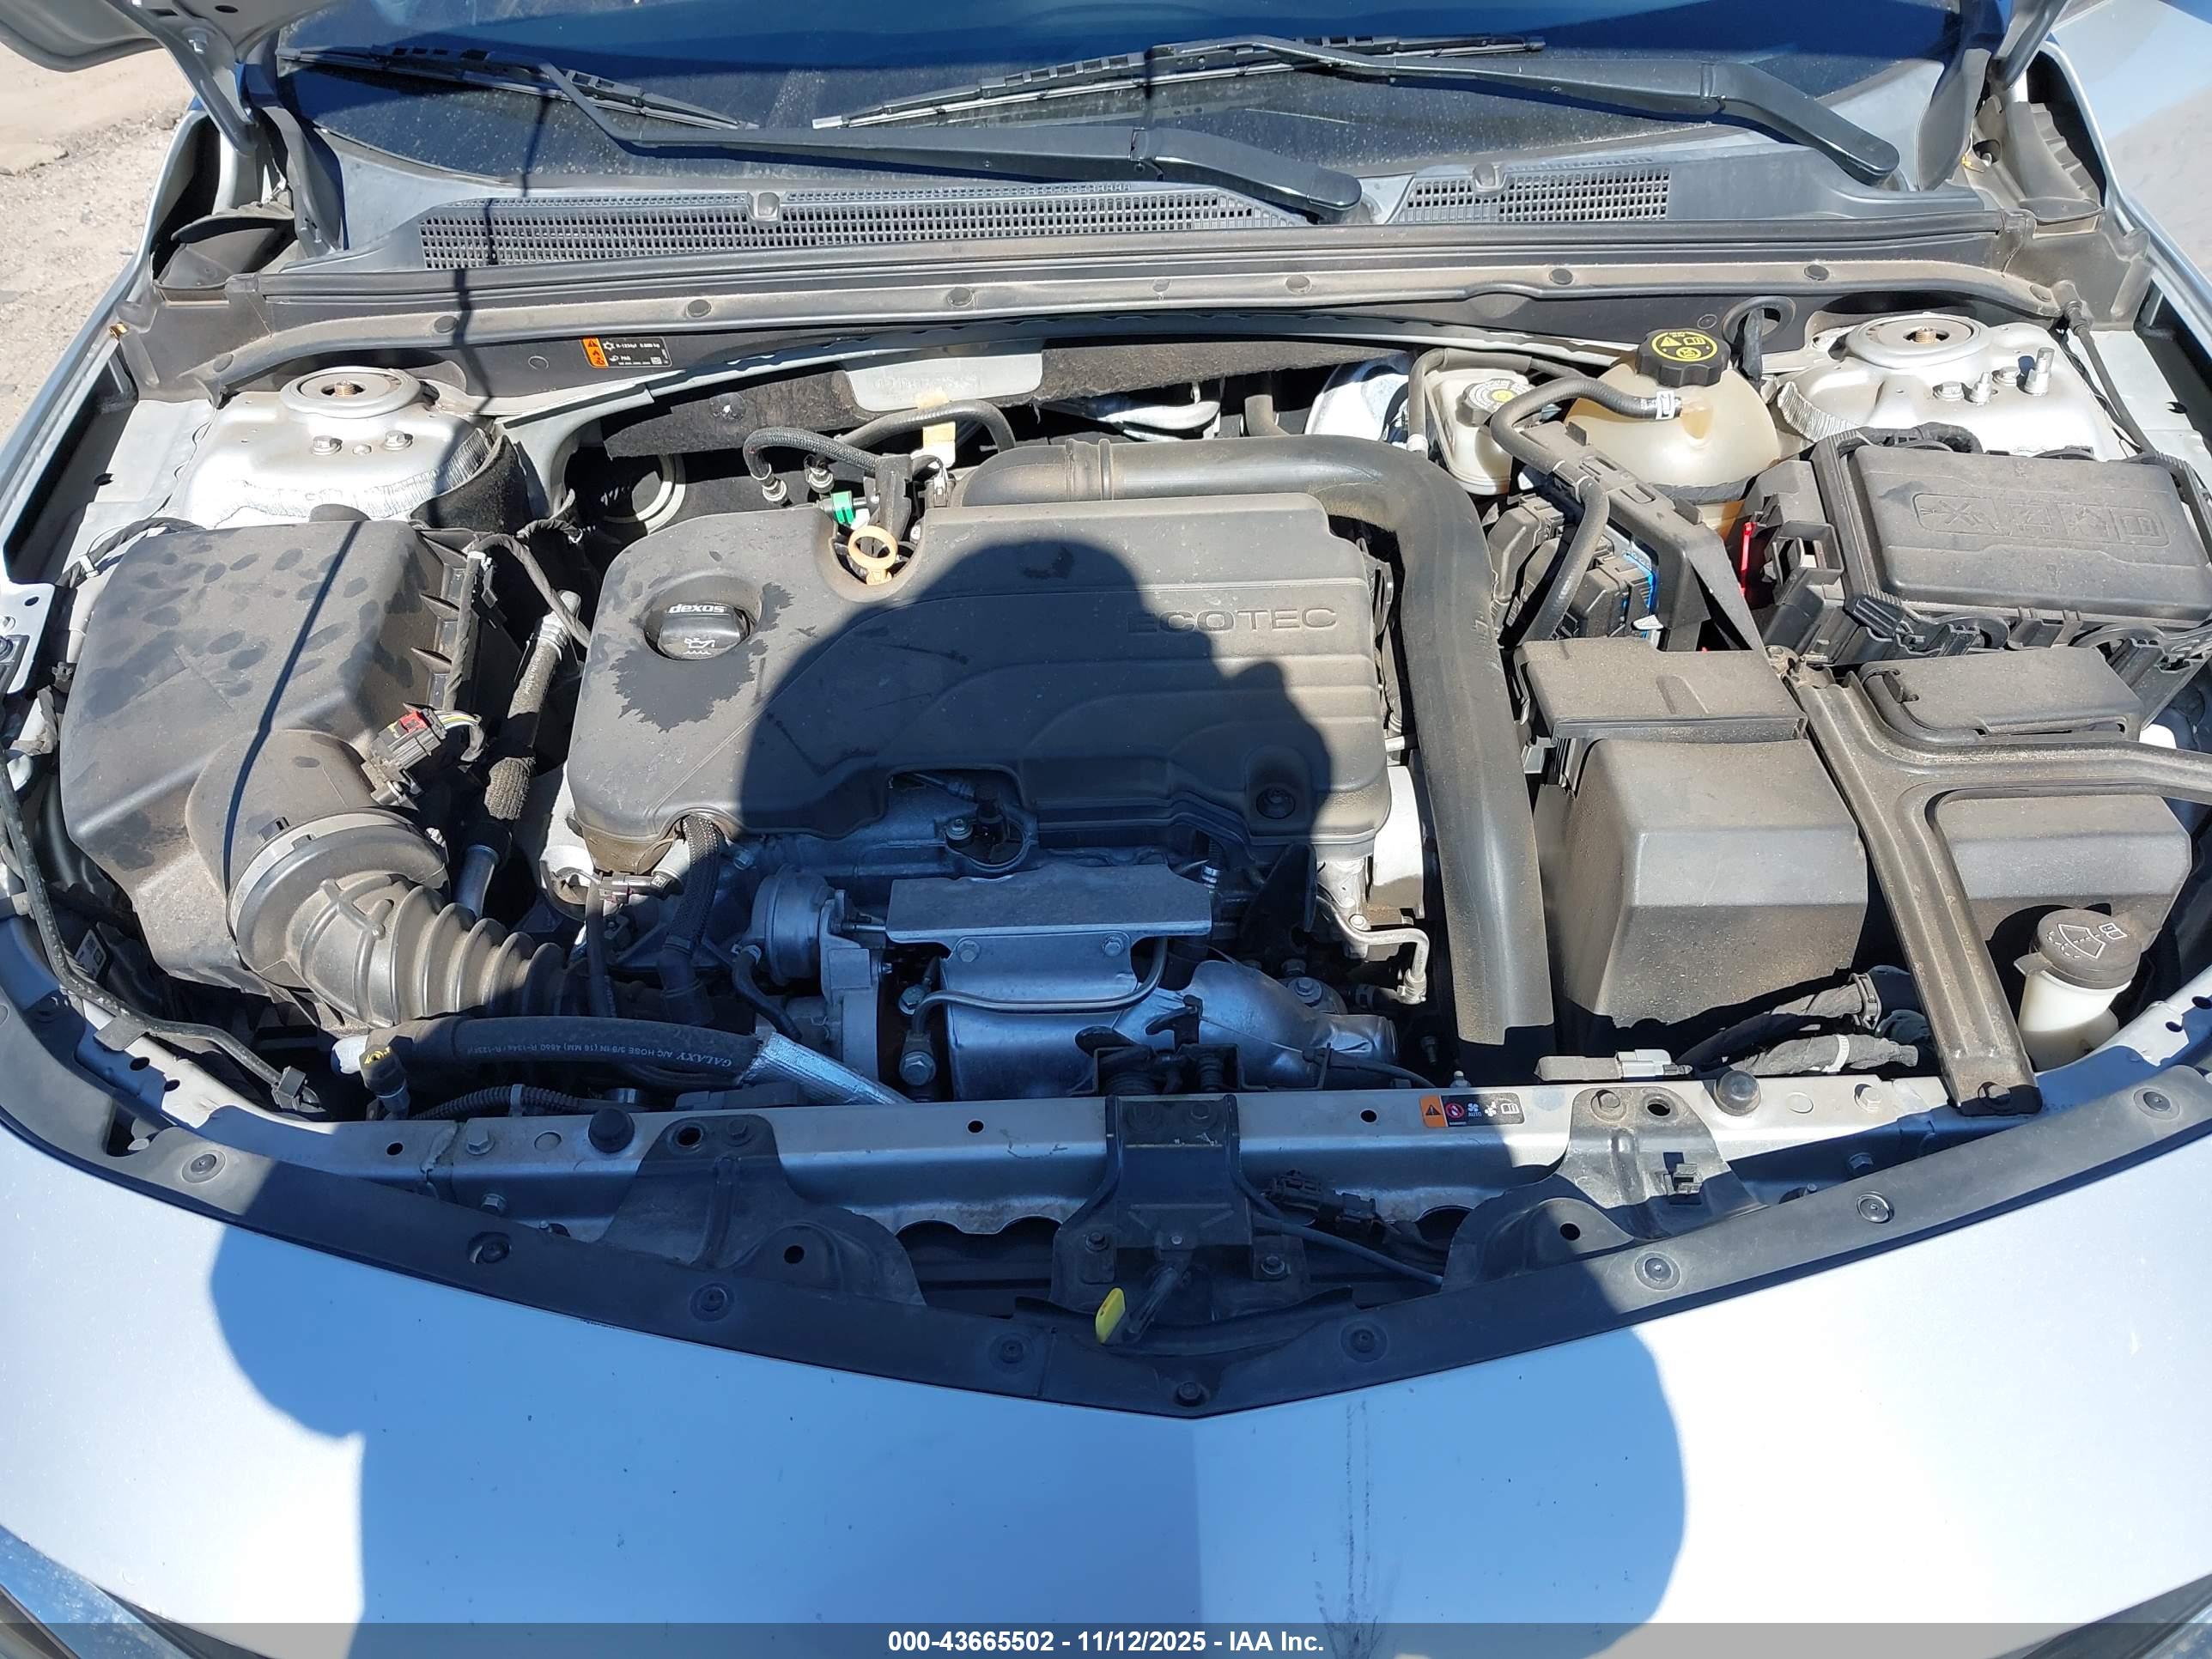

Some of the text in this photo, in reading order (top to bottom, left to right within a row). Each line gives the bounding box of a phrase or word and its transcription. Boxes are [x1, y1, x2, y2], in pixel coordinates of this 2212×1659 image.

[668, 603, 726, 614] dexos
[1126, 607, 1337, 633] ECOTEC
[628, 1046, 655, 1056] HOSE
[657, 1049, 673, 1058] A/C
[676, 1052, 732, 1067] GALAXY
